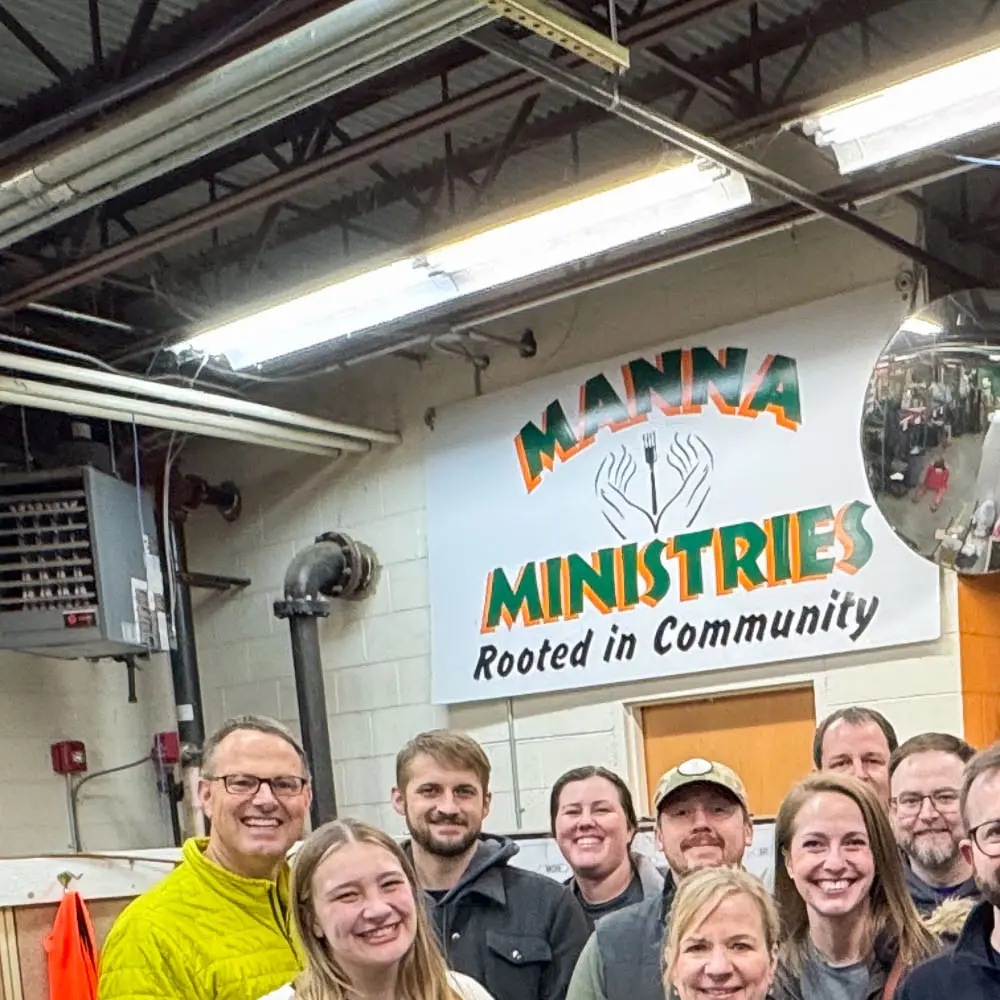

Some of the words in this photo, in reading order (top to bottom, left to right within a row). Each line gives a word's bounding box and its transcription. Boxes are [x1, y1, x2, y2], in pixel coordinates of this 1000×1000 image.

[514, 346, 803, 494] MANNA
[480, 500, 874, 634] MINISTRIES
[473, 629, 593, 681] Rooted
[603, 625, 636, 662] in
[653, 588, 880, 656] Community
